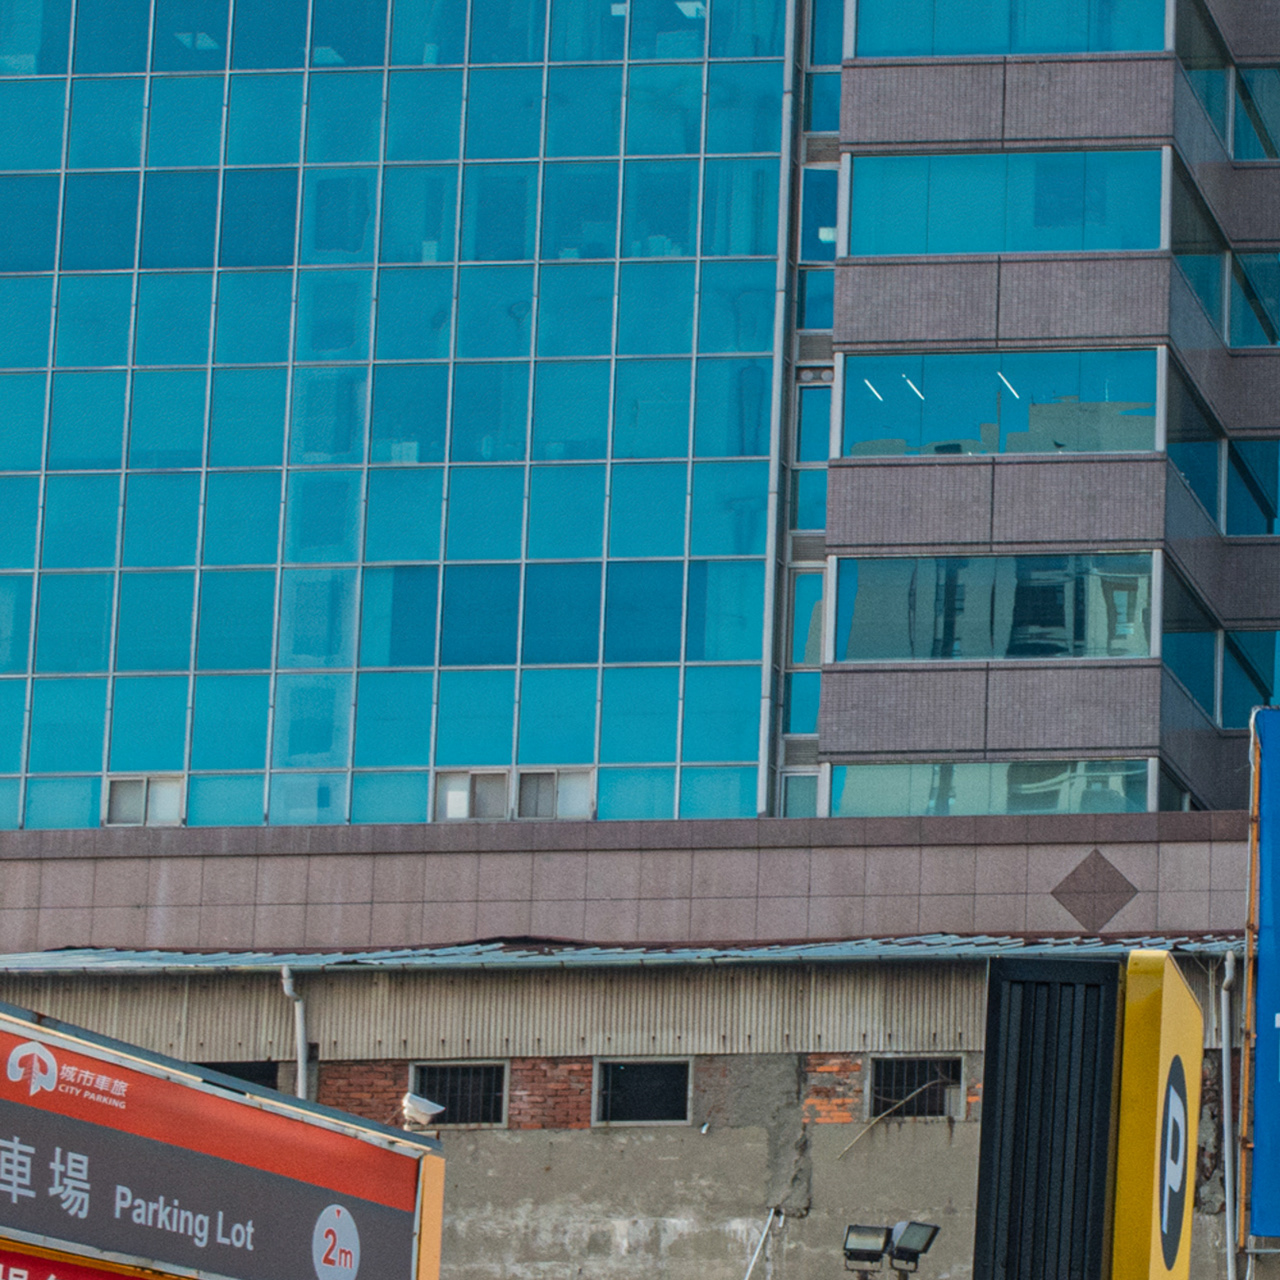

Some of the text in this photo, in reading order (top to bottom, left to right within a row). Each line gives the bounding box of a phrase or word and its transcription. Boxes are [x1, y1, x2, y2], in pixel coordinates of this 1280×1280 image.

[58, 1083, 127, 1110] CITY PARKING
[59, 1063, 129, 1098] 城市車旅
[0, 1136, 91, 1220] 車場
[1161, 1083, 1187, 1235] P
[114, 1184, 255, 1251] Parking Lot
[321, 1227, 354, 1270] 2m
